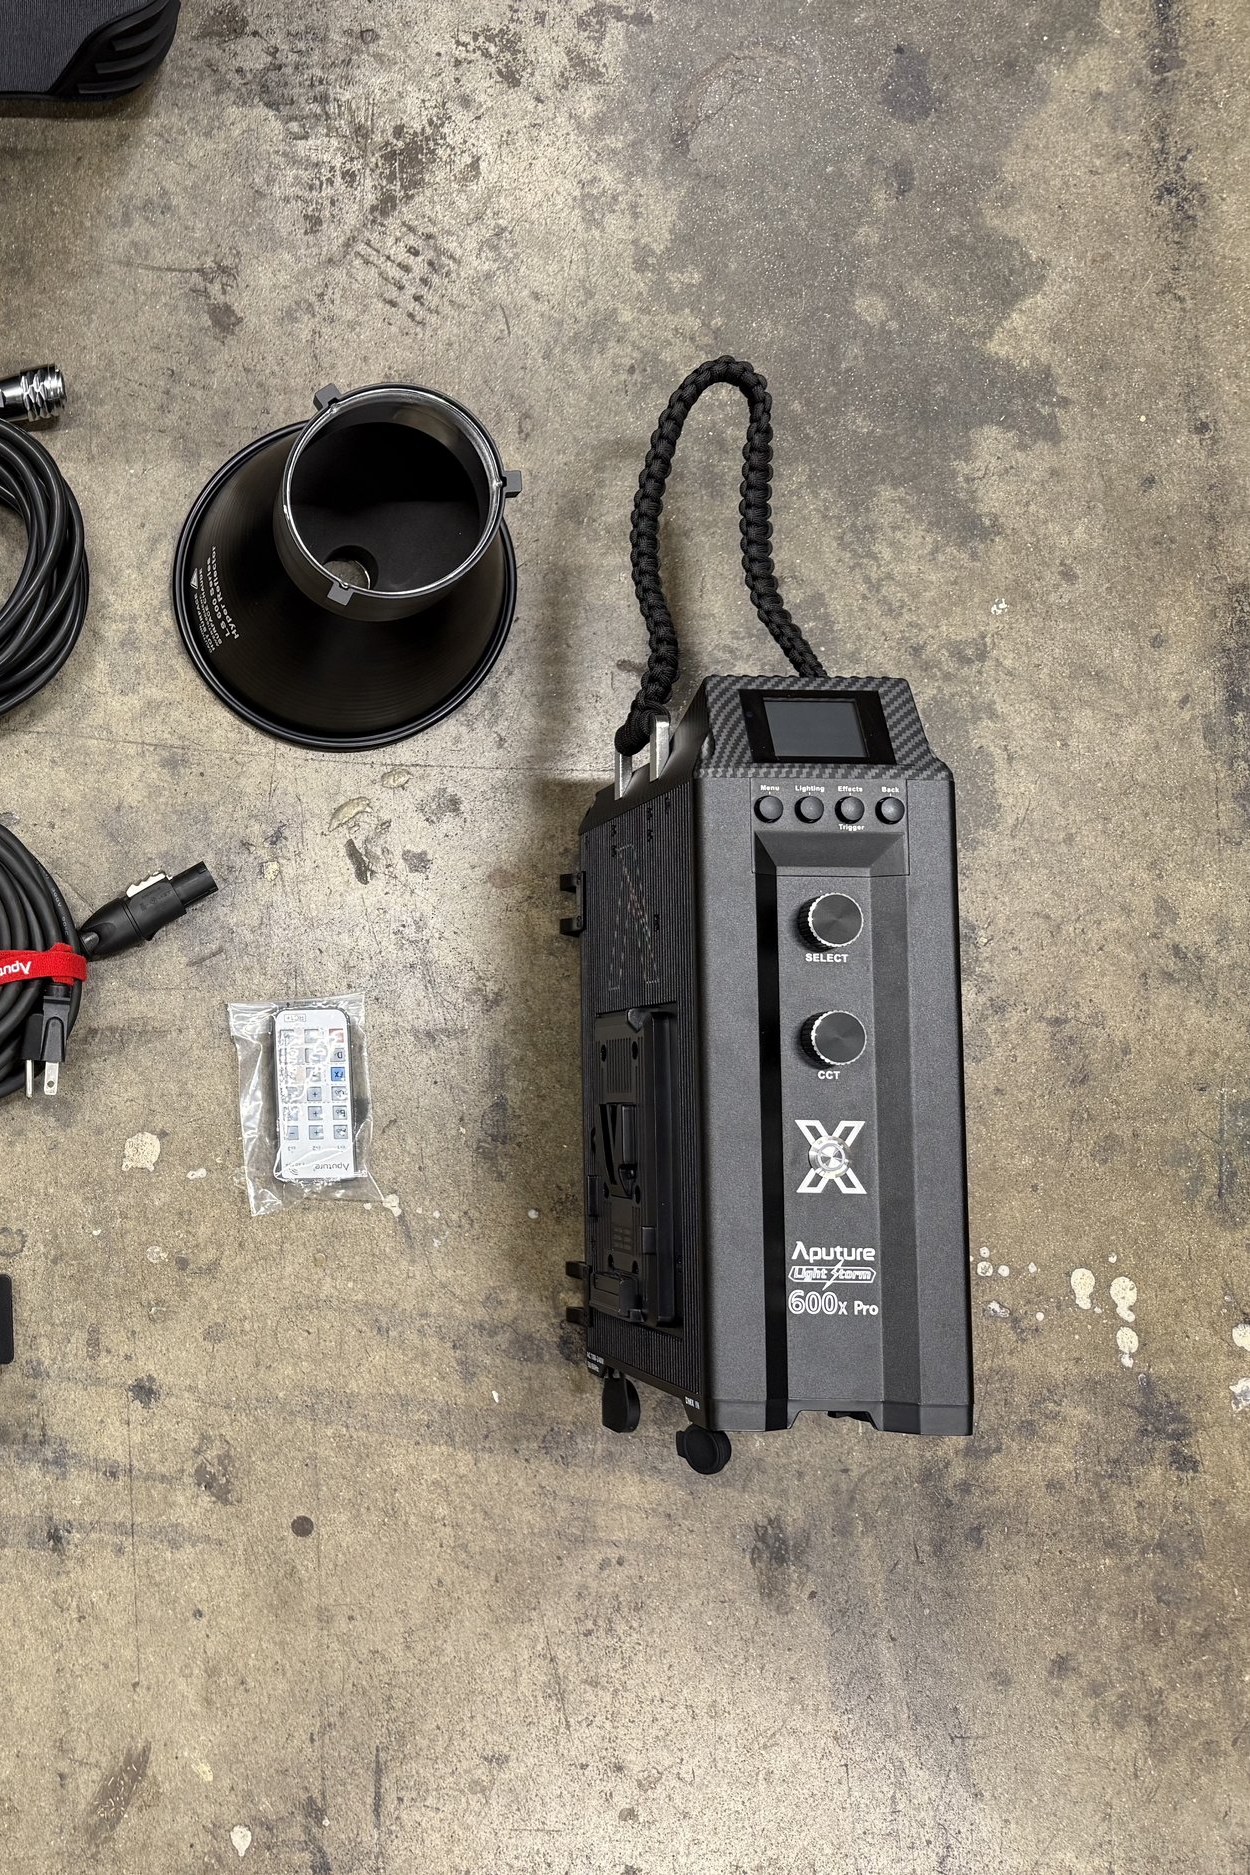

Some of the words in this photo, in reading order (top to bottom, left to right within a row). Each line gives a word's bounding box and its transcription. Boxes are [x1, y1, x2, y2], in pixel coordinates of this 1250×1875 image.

[206, 556, 215, 596] Series
[211, 545, 224, 603] Reflector
[220, 603, 240, 640] Hyper
[220, 620, 231, 638] LS
[760, 784, 780, 792] Menu
[794, 784, 825, 793] Lighting
[837, 785, 863, 793] Effects
[838, 823, 865, 832] Trigger
[805, 953, 849, 963] SELECT
[817, 1070, 841, 1080] CCT
[314, 1161, 350, 1171] Aputure
[791, 1241, 876, 1263] Aputure
[853, 1300, 879, 1316] Pro
